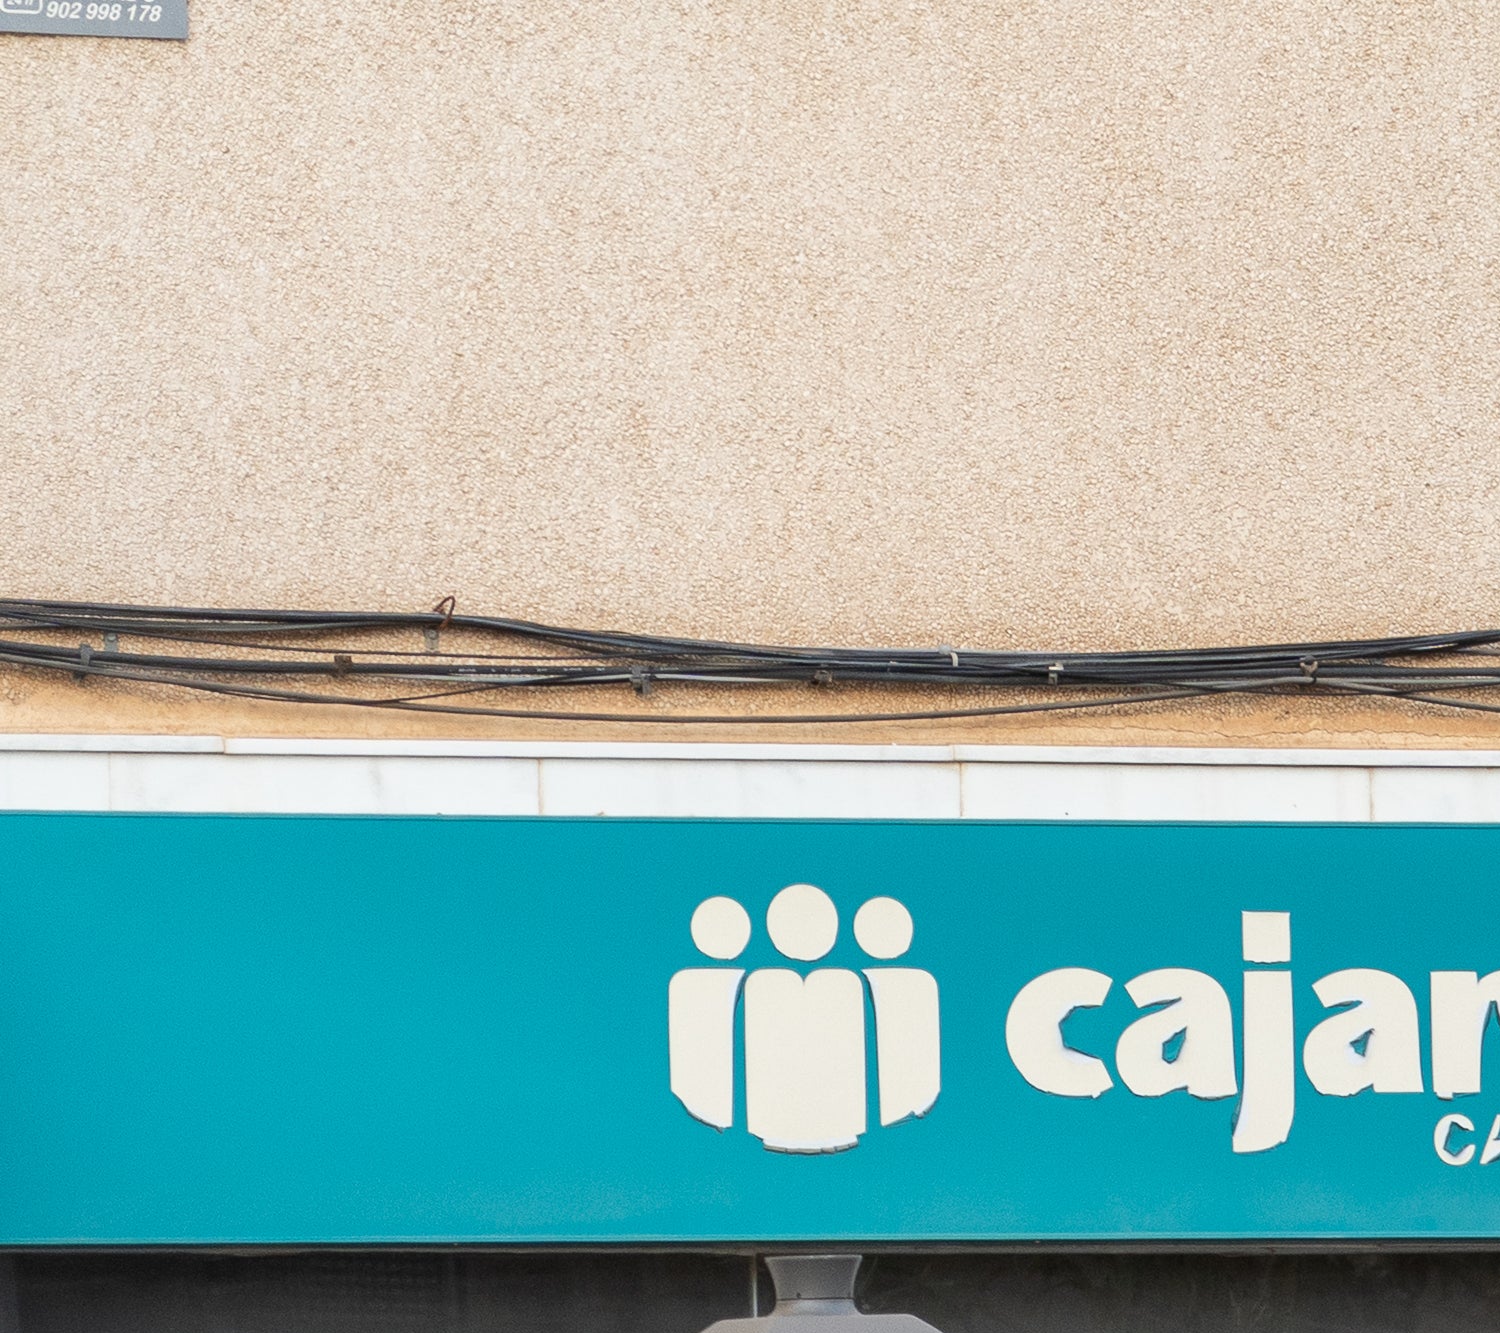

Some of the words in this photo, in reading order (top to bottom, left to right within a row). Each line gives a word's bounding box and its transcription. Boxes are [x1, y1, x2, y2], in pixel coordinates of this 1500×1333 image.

[46, 1, 82, 19] 902
[85, 3, 122, 21] 998
[127, 4, 162, 22] 178
